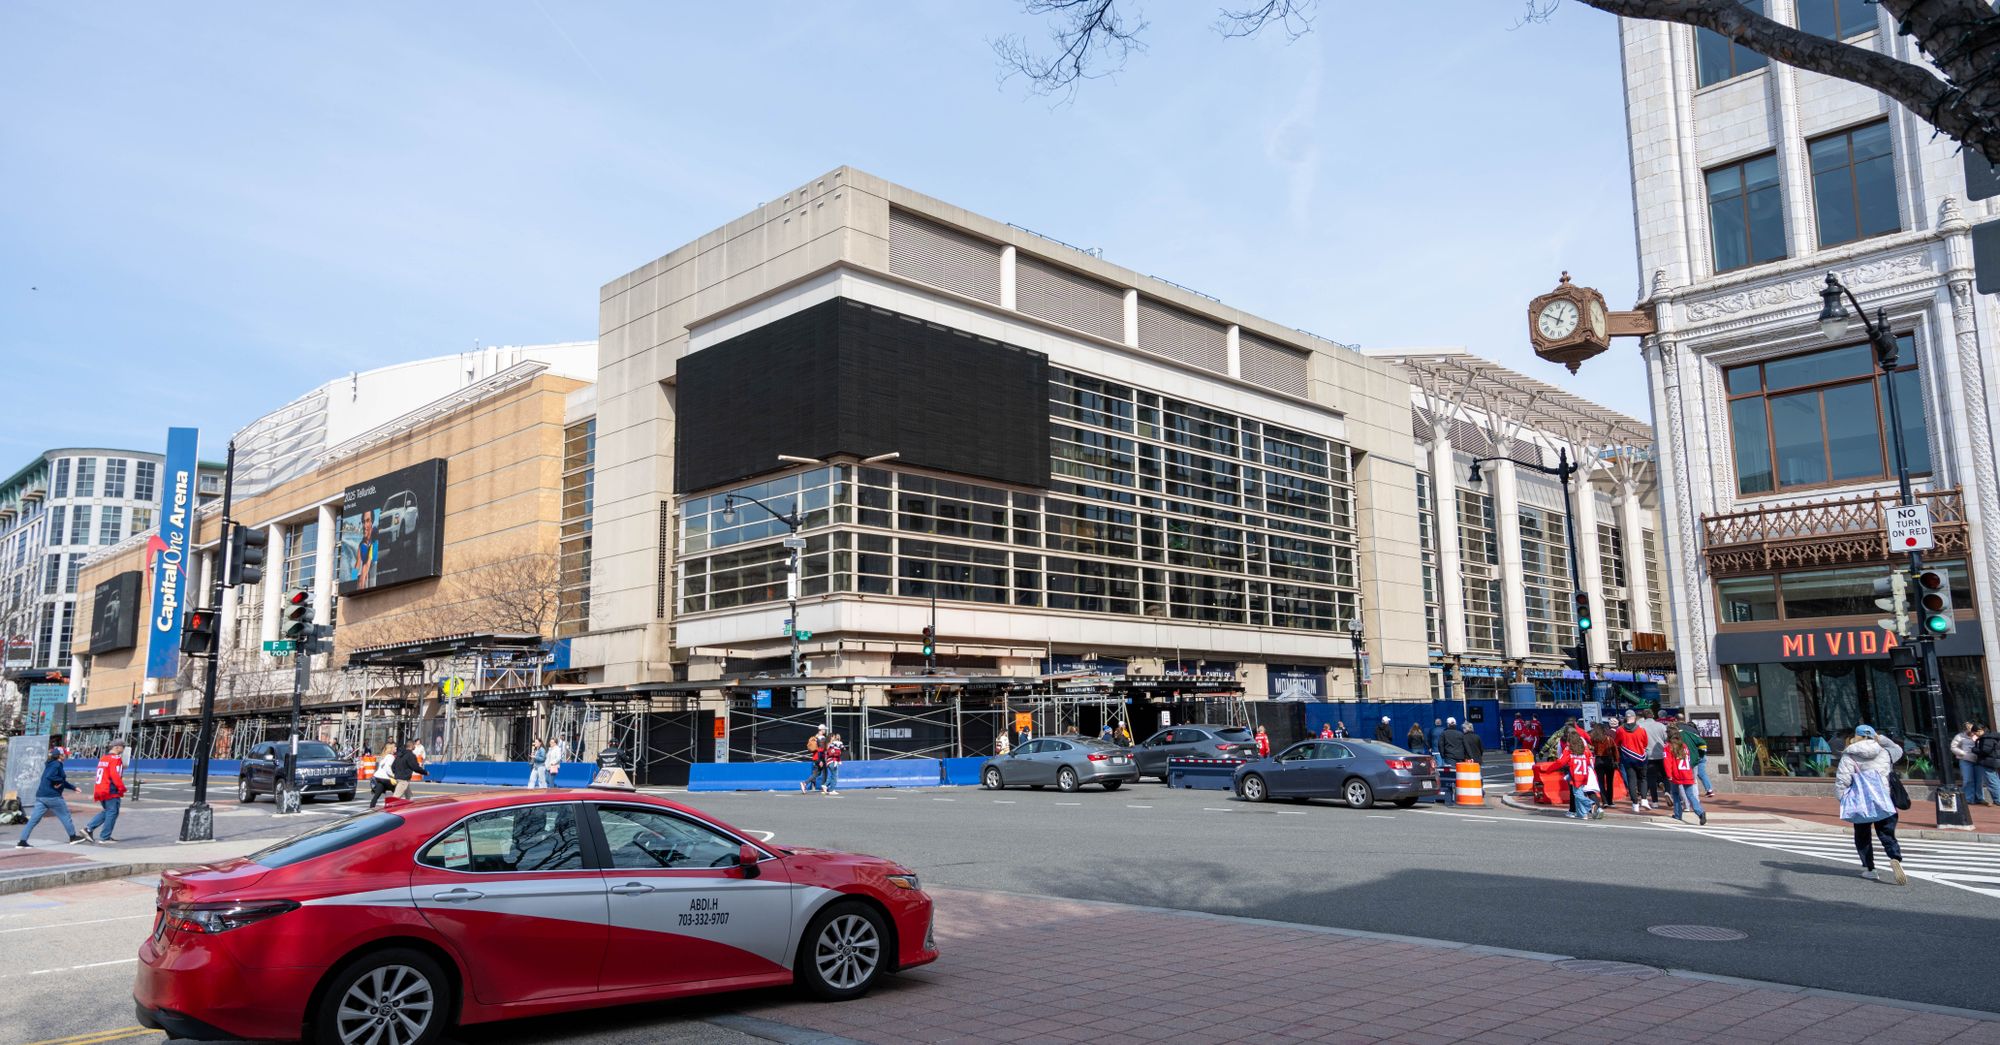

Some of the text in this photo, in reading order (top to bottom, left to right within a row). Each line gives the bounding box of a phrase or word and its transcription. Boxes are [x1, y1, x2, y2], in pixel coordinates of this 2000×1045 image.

[170, 470, 188, 529] Arena
[1897, 509, 1916, 518] NO
[1896, 519, 1921, 528] TURN
[1892, 527, 1928, 538] ON RED
[272, 641, 279, 649] F
[1782, 629, 1899, 657] MI VIDA
[1905, 669, 1915, 685] 9
[1573, 759, 1588, 775] 21
[689, 897, 719, 911] ABDI.H
[678, 912, 730, 927] 703-332-9707
